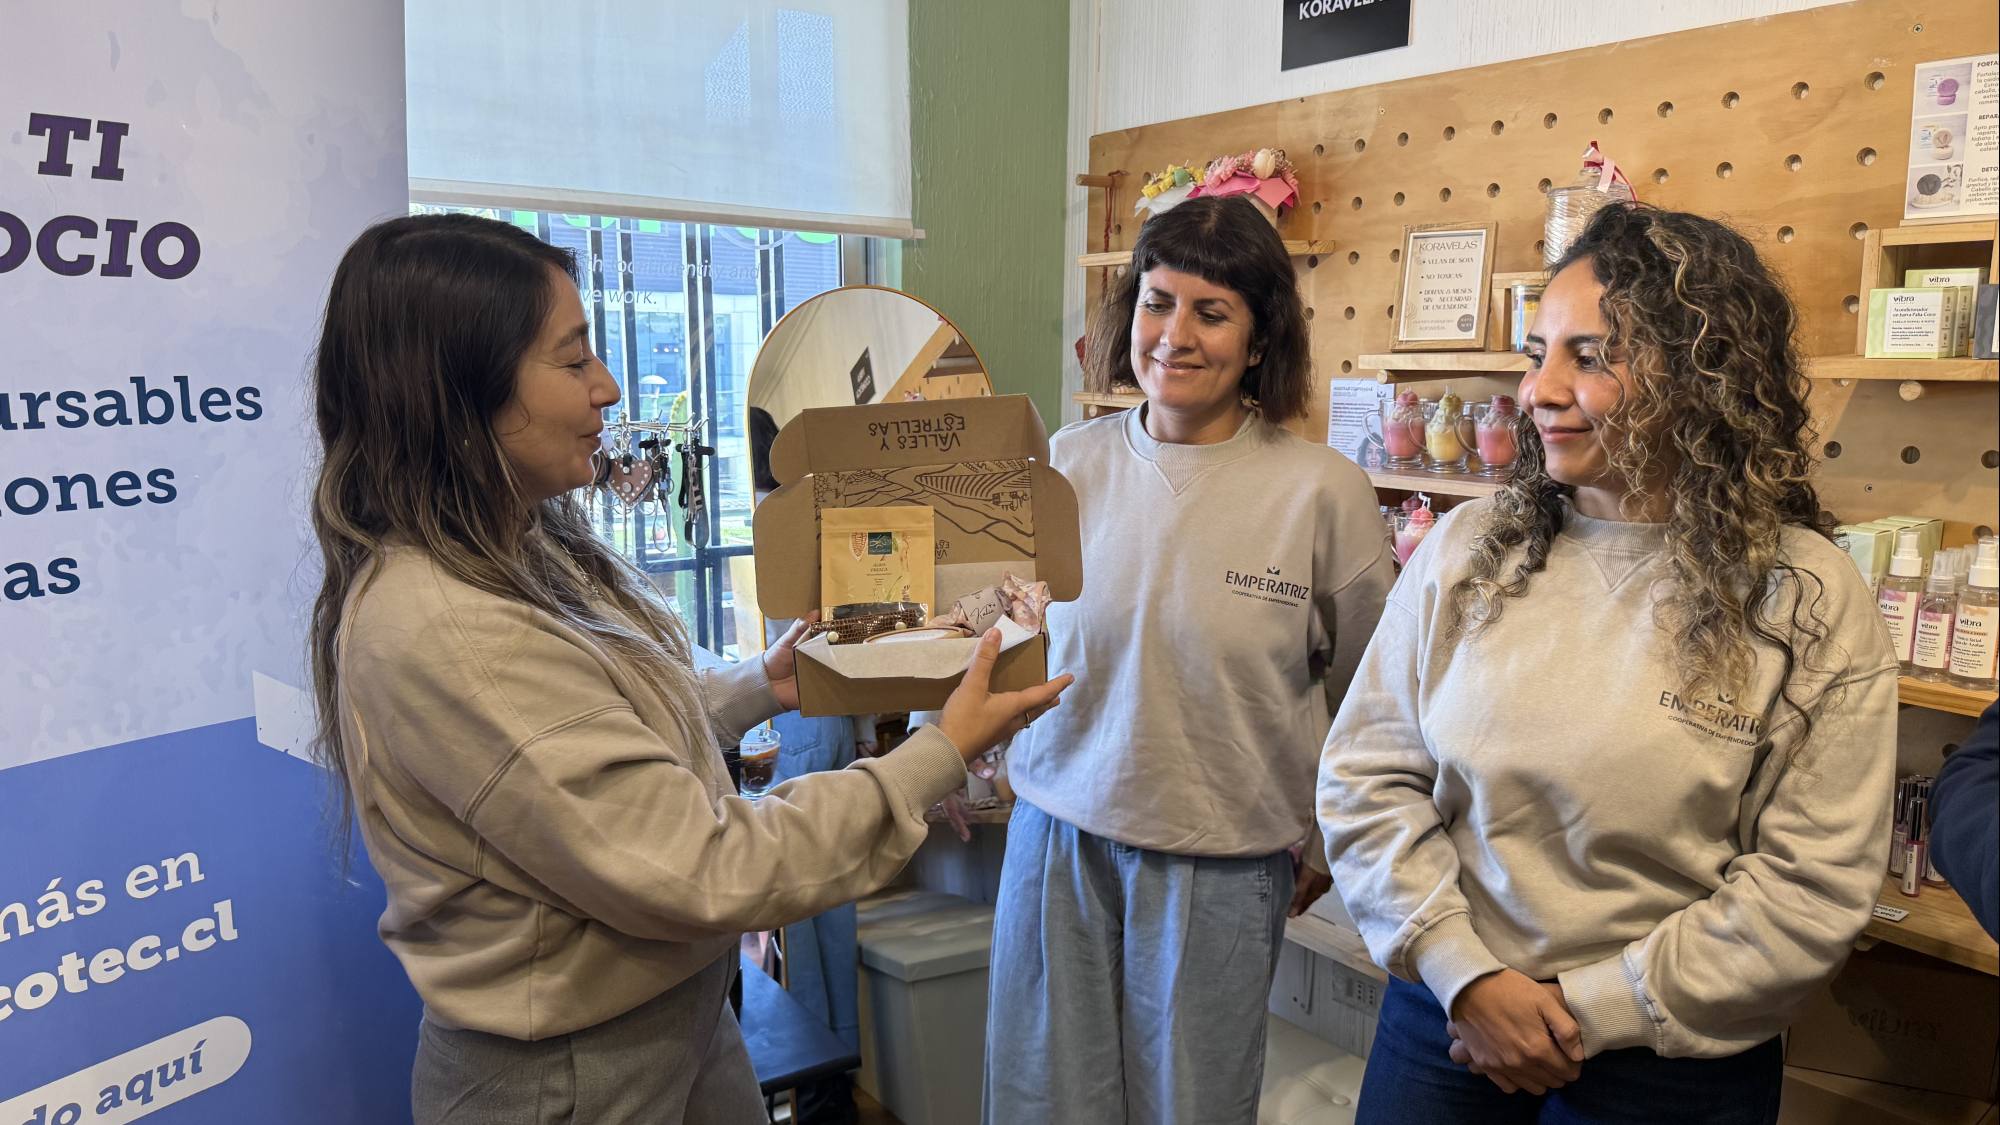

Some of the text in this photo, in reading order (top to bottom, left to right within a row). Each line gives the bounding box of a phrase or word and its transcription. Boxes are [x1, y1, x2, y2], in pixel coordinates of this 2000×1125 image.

[28, 113, 129, 181] TI
[1419, 241, 1478, 253] KORAVELAS
[608, 288, 657, 305] work.
[1893, 295, 1915, 303] vibra
[868, 413, 966, 437] ESTRELLAS
[880, 432, 960, 452] VALLES Y
[0, 468, 177, 516] ones
[1225, 570, 1310, 600] EMPERATRIZ
[1960, 618, 1982, 627] vibra
[1667, 715, 1708, 733] COOPERATIVA
[1708, 728, 1716, 737] DE
[125, 852, 205, 899] en
[96, 1039, 207, 1114] aquí
